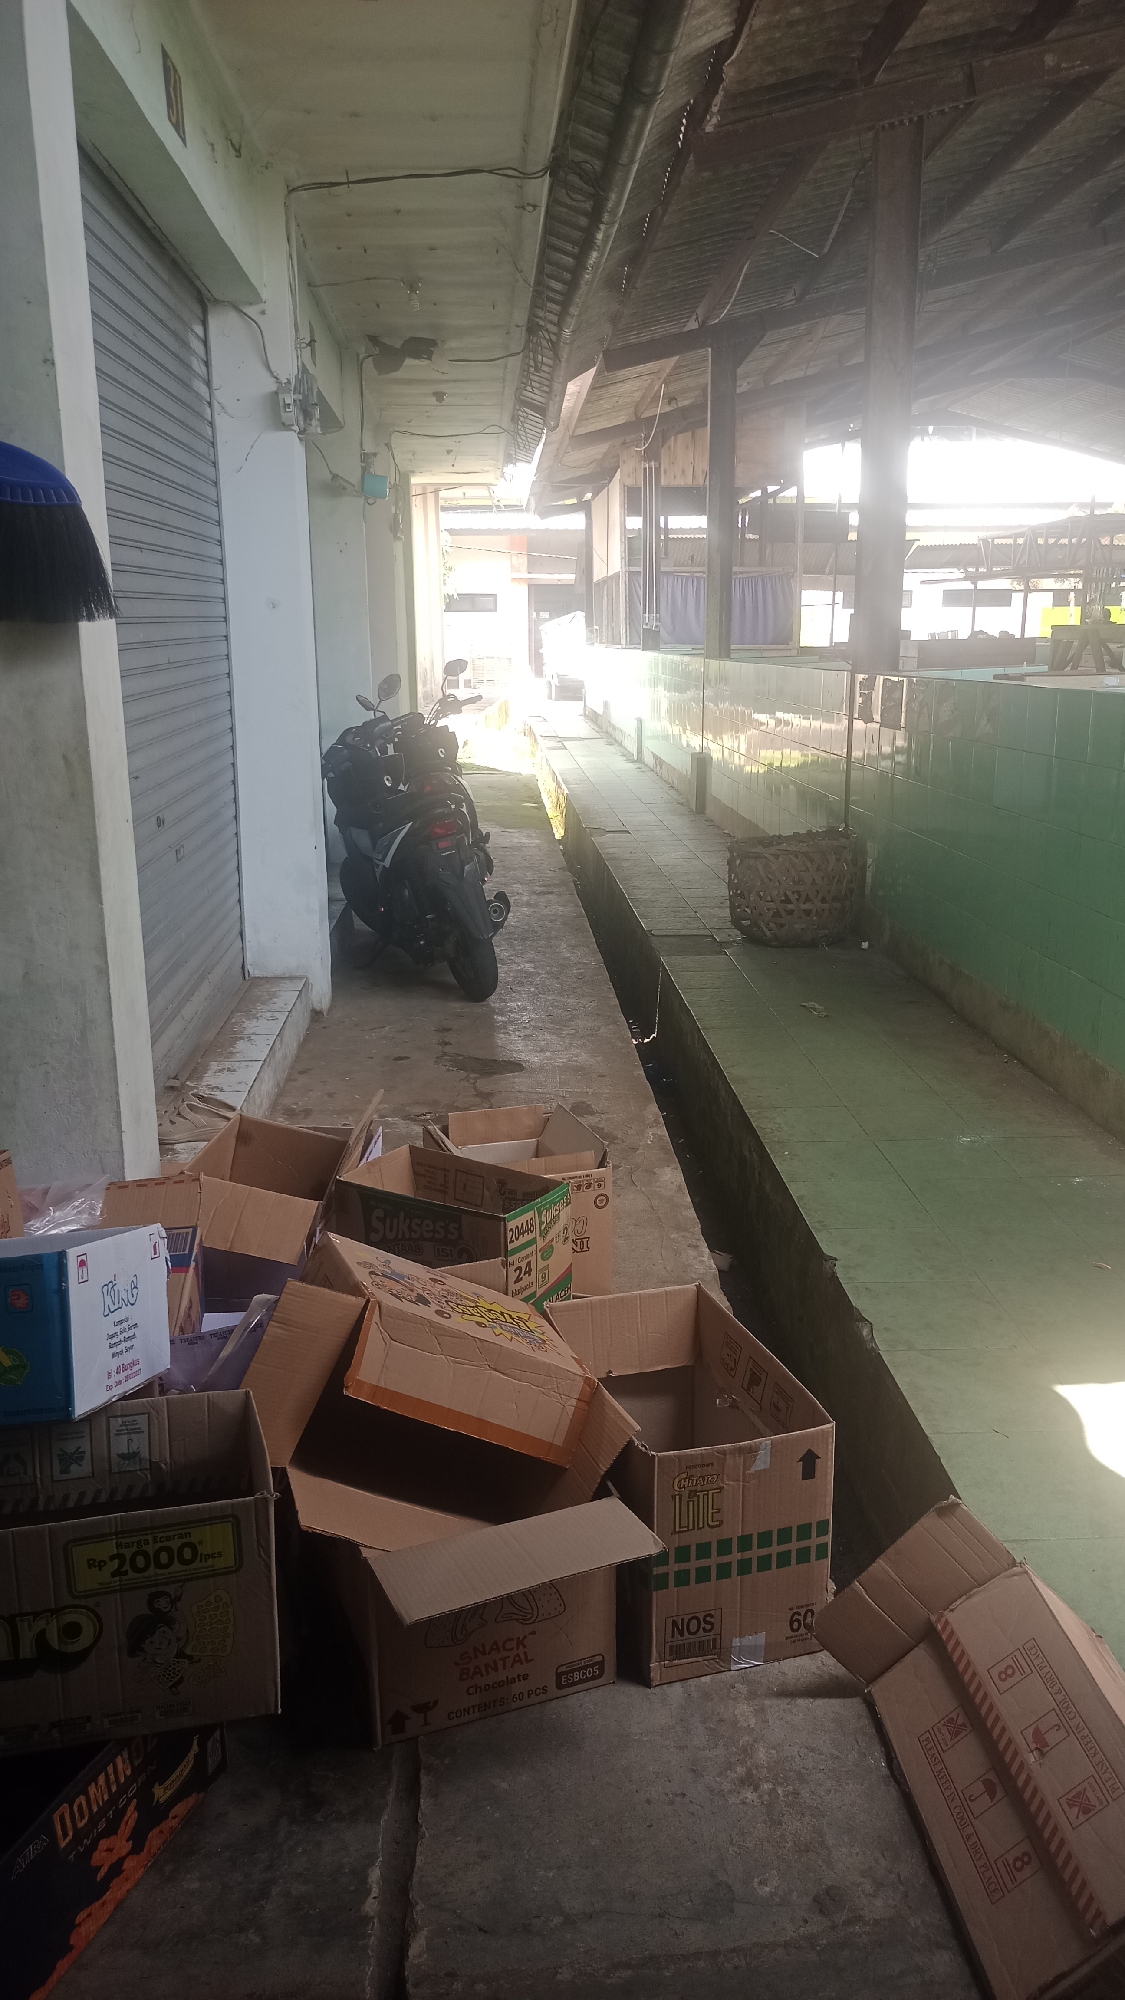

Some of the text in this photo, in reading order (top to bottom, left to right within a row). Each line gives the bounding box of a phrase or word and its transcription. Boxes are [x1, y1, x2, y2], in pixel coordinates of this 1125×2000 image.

[369, 1208, 459, 1242] Sukses's
[508, 1216, 534, 1245] 20448
[513, 1260, 533, 1285] 24
[115, 1531, 192, 1550] Harga Eceran
[671, 1612, 715, 1639] NOS
[788, 1608, 816, 1633] 60
[459, 1634, 528, 1666] SNACK
[1026, 1642, 1048, 1671] PLACE
[458, 1650, 534, 1682] BANTAL
[997, 1664, 1016, 1682] 8
[1042, 1669, 1059, 1689] DRY
[466, 1672, 530, 1696] Chocolate
[1052, 1685, 1063, 1697] &
[447, 1685, 549, 1721] CONTENTS: 60 PCS
[1057, 1693, 1078, 1721] COOL
[1072, 1720, 1085, 1734] IN
[921, 1735, 941, 1768] PLEASE
[1079, 1731, 1099, 1759] KEEP
[935, 1766, 952, 1793] KEEP
[1093, 1756, 1120, 1794] PLEASE
[946, 1790, 957, 1803] IN
[951, 1803, 970, 1832] COOL
[68, 1805, 116, 1862] TWIST
[964, 1830, 974, 1842] &
[968, 1840, 984, 1864] DRY
[1012, 1850, 1032, 1873] 8
[978, 1861, 999, 1898] PLACE
